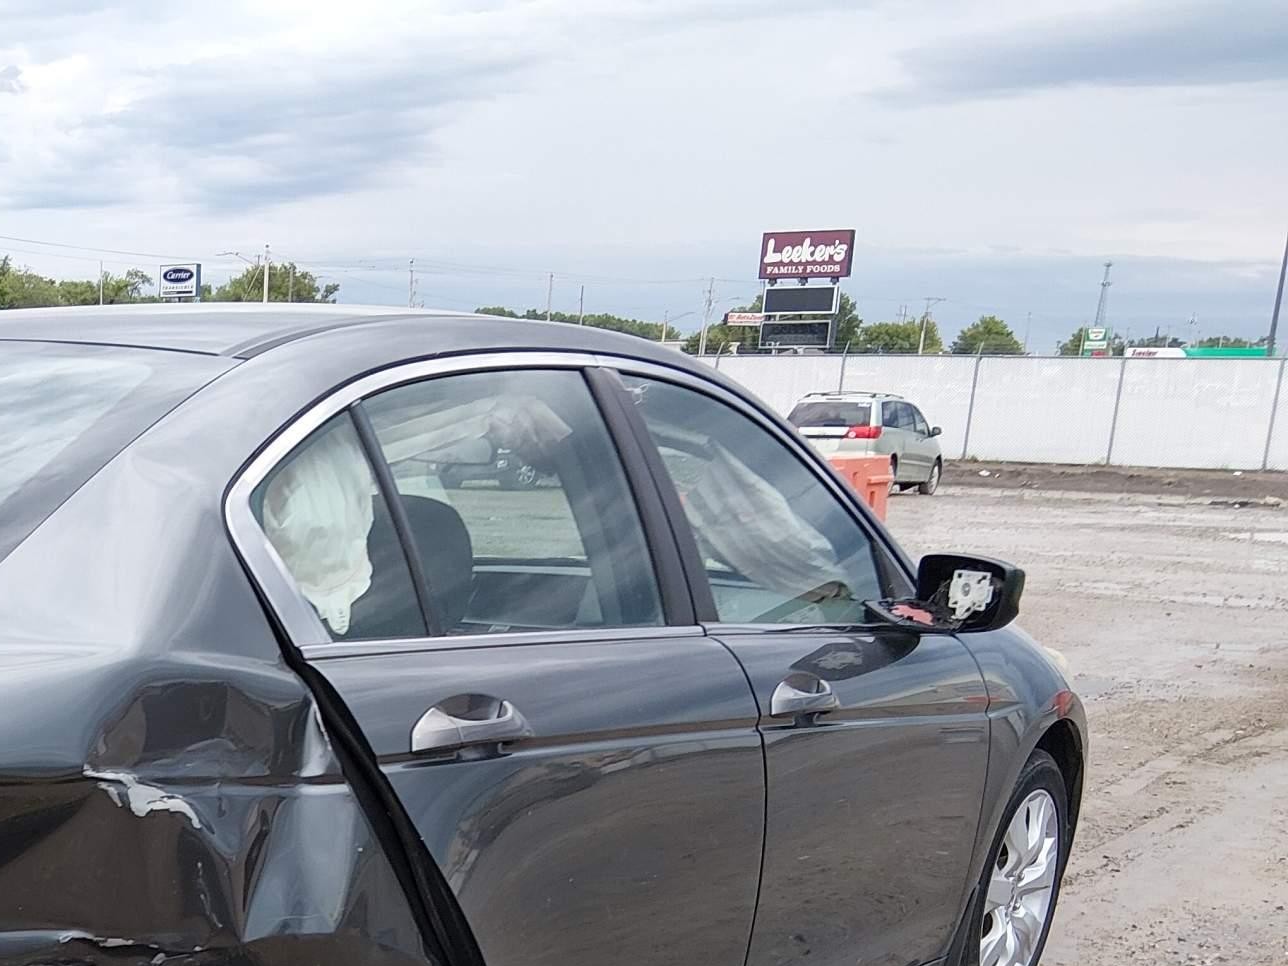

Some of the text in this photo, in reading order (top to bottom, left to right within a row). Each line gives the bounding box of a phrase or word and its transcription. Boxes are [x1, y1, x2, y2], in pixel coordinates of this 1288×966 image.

[763, 237, 848, 263] Leeker's
[766, 264, 841, 274] FAMILY FOODS
[166, 271, 191, 280] Carrier
